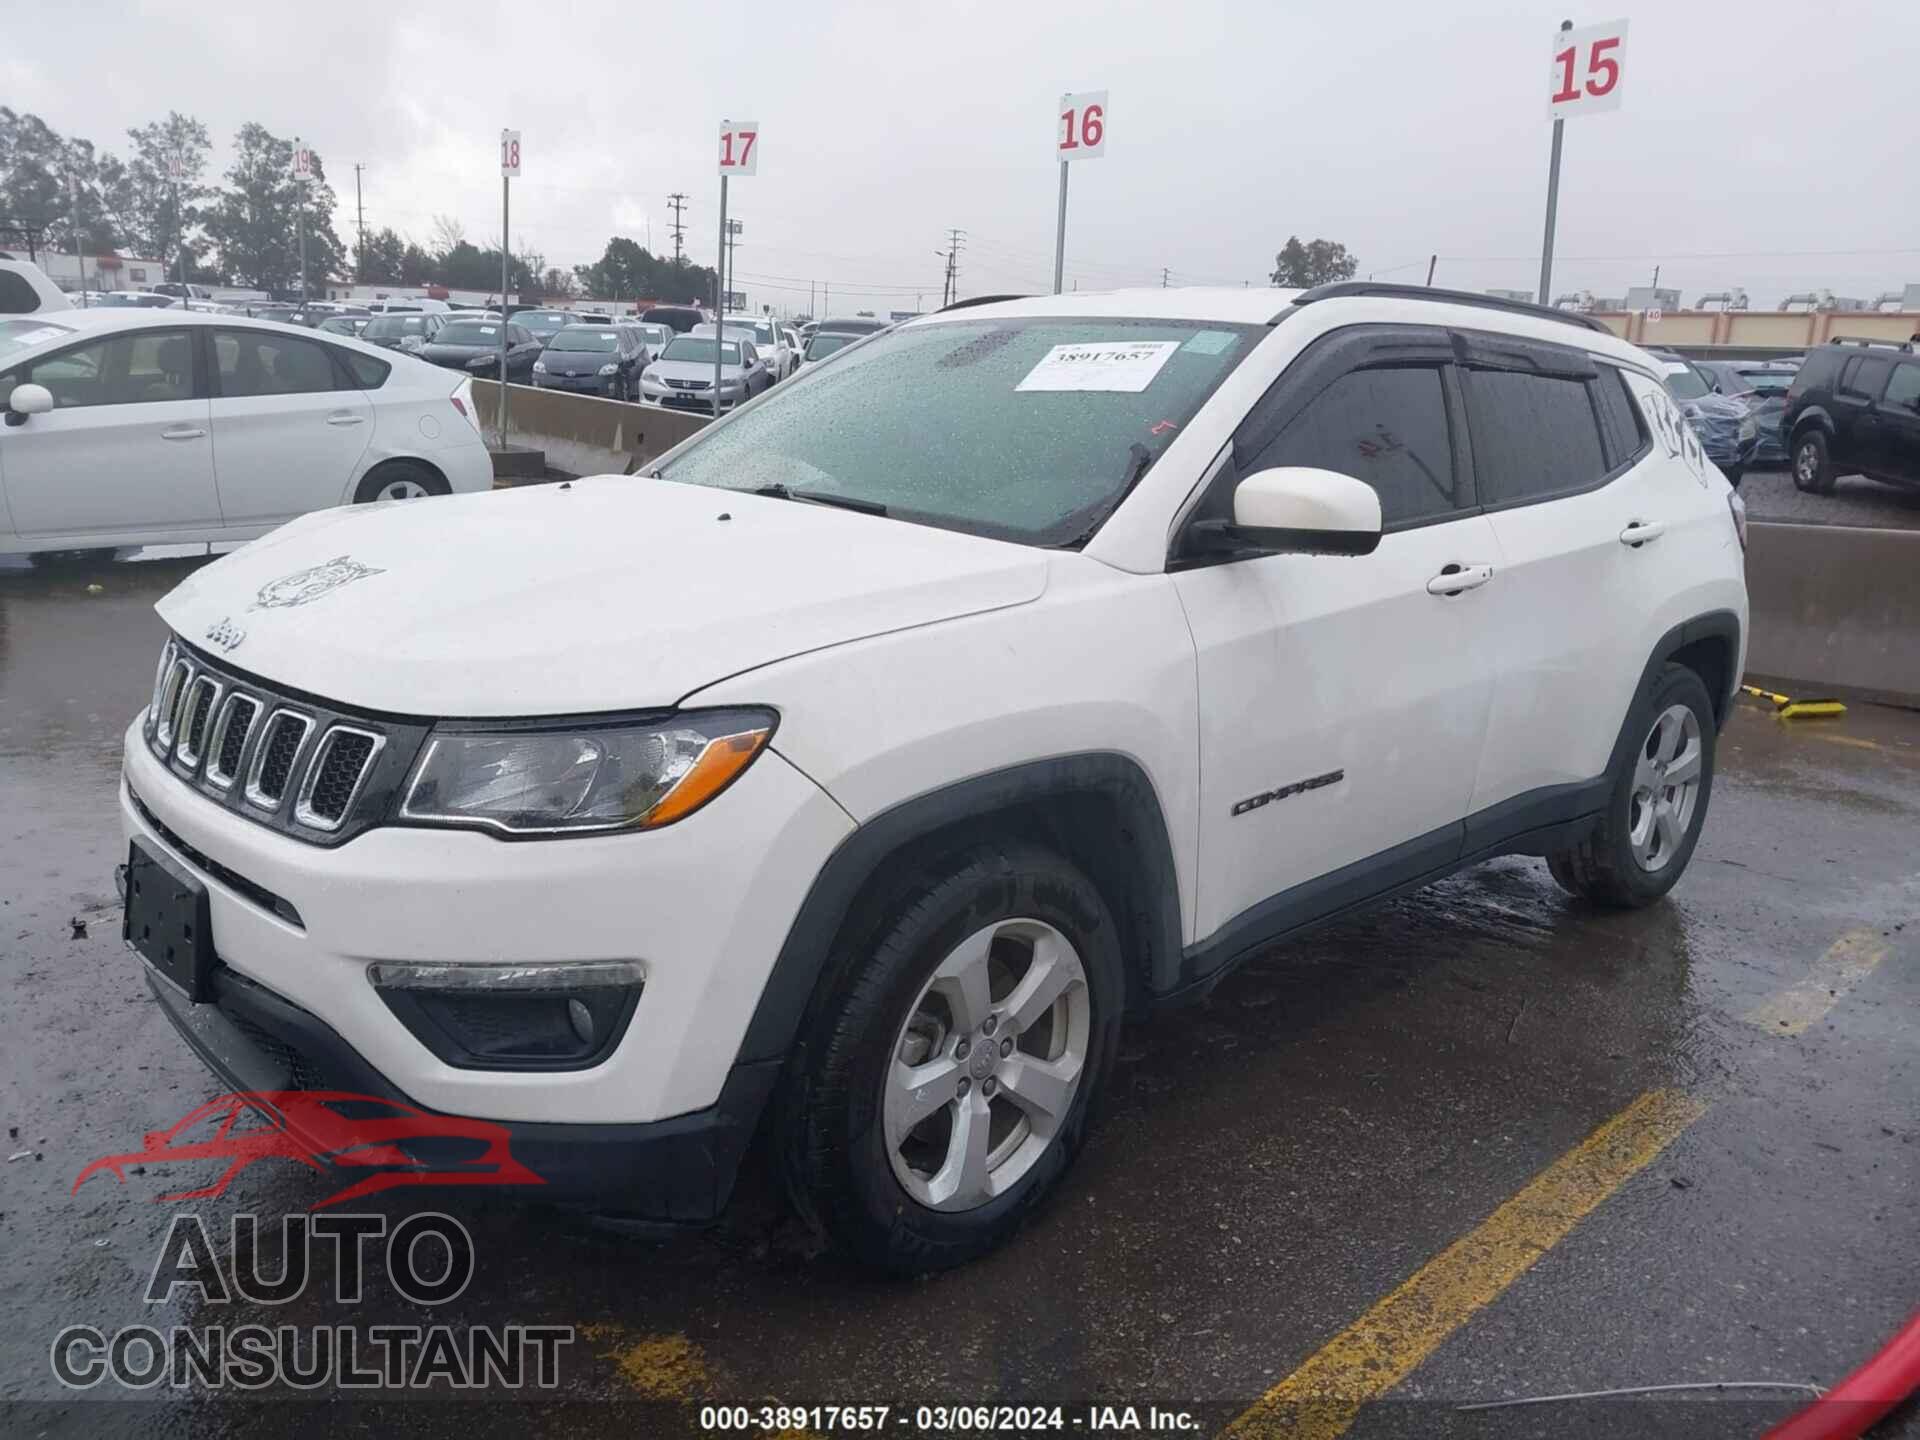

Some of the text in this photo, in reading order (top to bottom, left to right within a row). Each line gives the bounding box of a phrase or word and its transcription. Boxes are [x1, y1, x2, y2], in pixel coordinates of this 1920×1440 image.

[1552, 37, 1620, 103] 15
[1060, 104, 1103, 149] 16
[295, 150, 310, 173] 19
[501, 139, 520, 168] 18
[720, 132, 757, 167] 17
[1230, 768, 1345, 817] COMPASS
